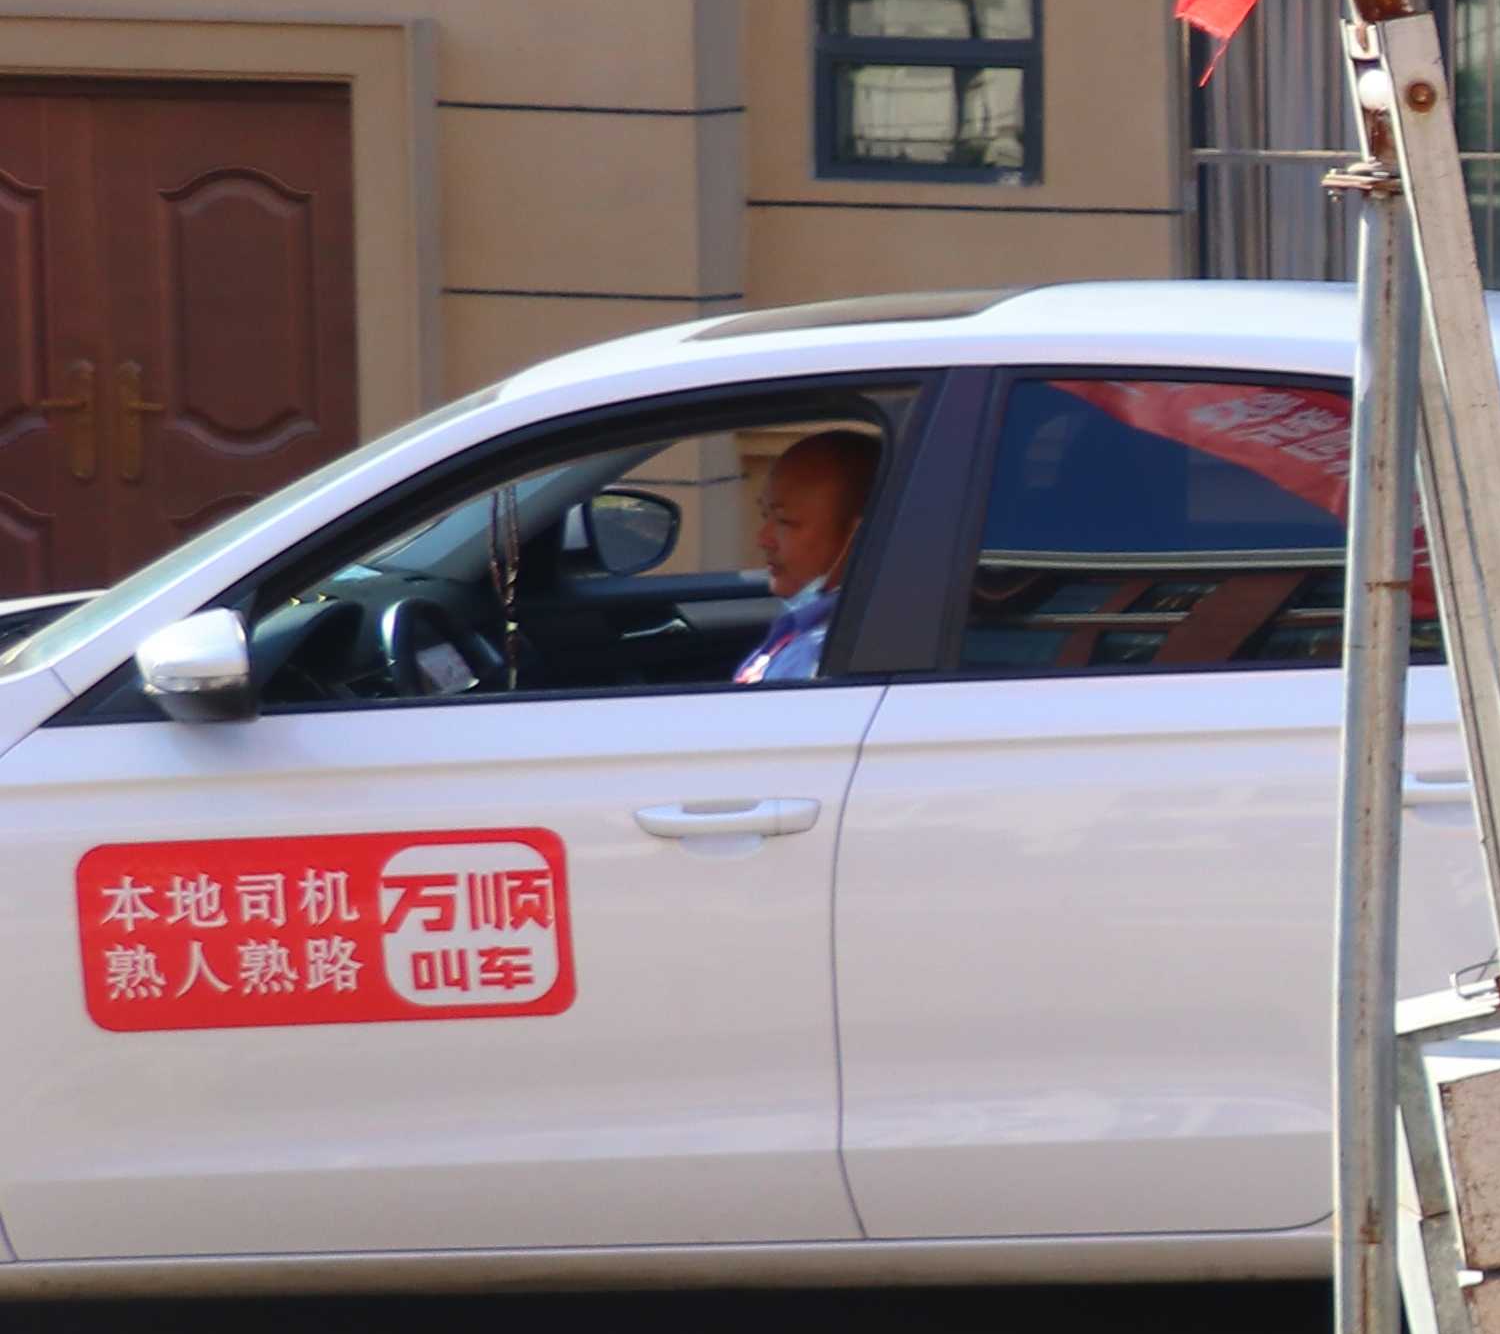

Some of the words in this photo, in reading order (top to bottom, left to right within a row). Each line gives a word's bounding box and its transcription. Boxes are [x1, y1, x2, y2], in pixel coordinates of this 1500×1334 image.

[101, 868, 361, 932] 本地司机
[382, 869, 555, 933] 万顺
[106, 938, 364, 1000] 熟人熟路
[410, 946, 535, 992] 叫车
